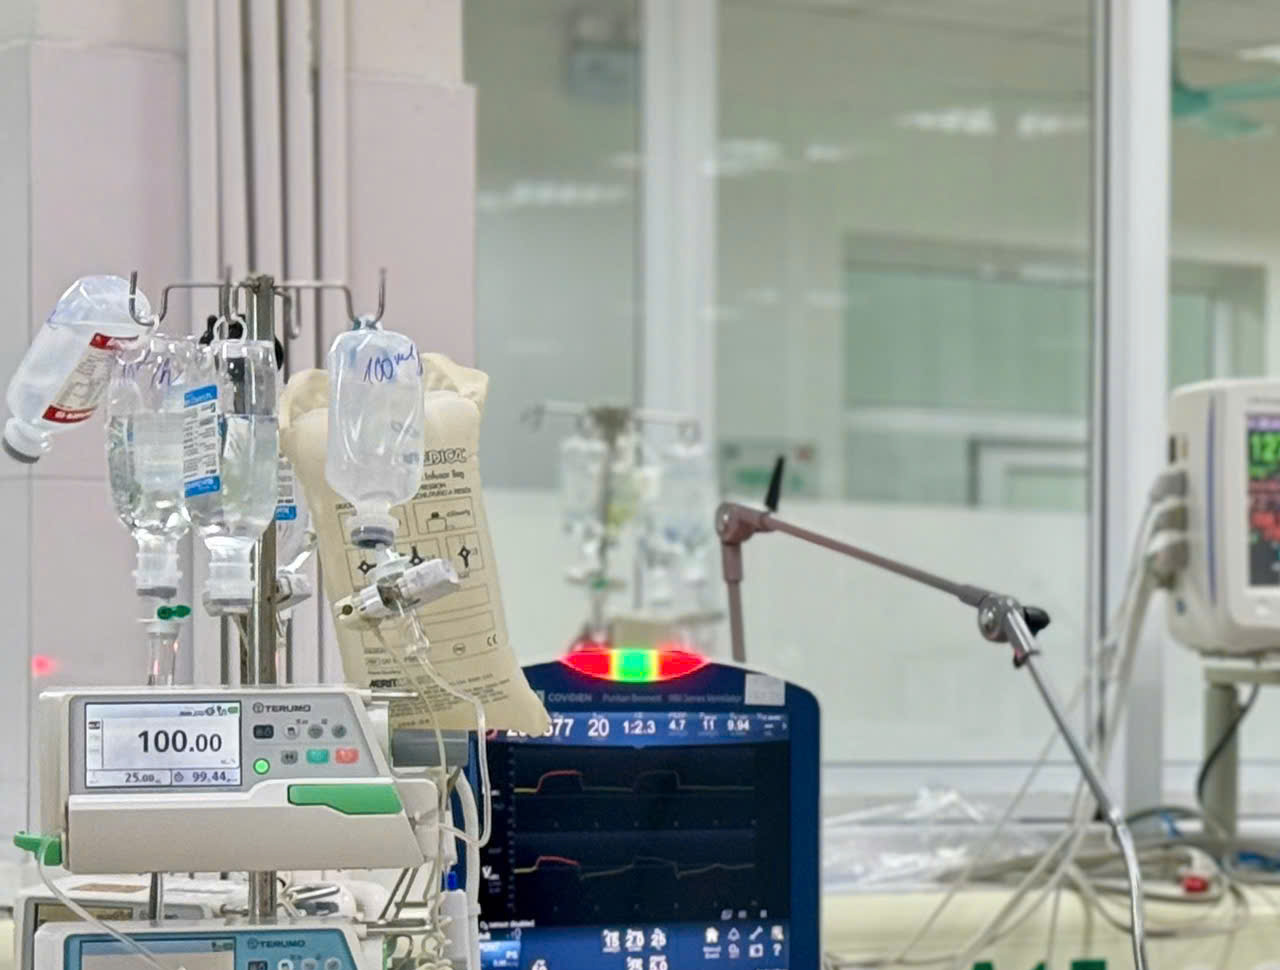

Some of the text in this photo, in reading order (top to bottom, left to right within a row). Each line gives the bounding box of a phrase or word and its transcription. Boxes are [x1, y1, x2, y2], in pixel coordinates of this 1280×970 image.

[548, 692, 593, 703] COVIDIEN
[265, 705, 312, 713] TERUMO
[587, 718, 610, 737] 20
[623, 720, 656, 735] 1:2.3
[668, 720, 686, 731] 4.7
[138, 730, 222, 753] 100.00
